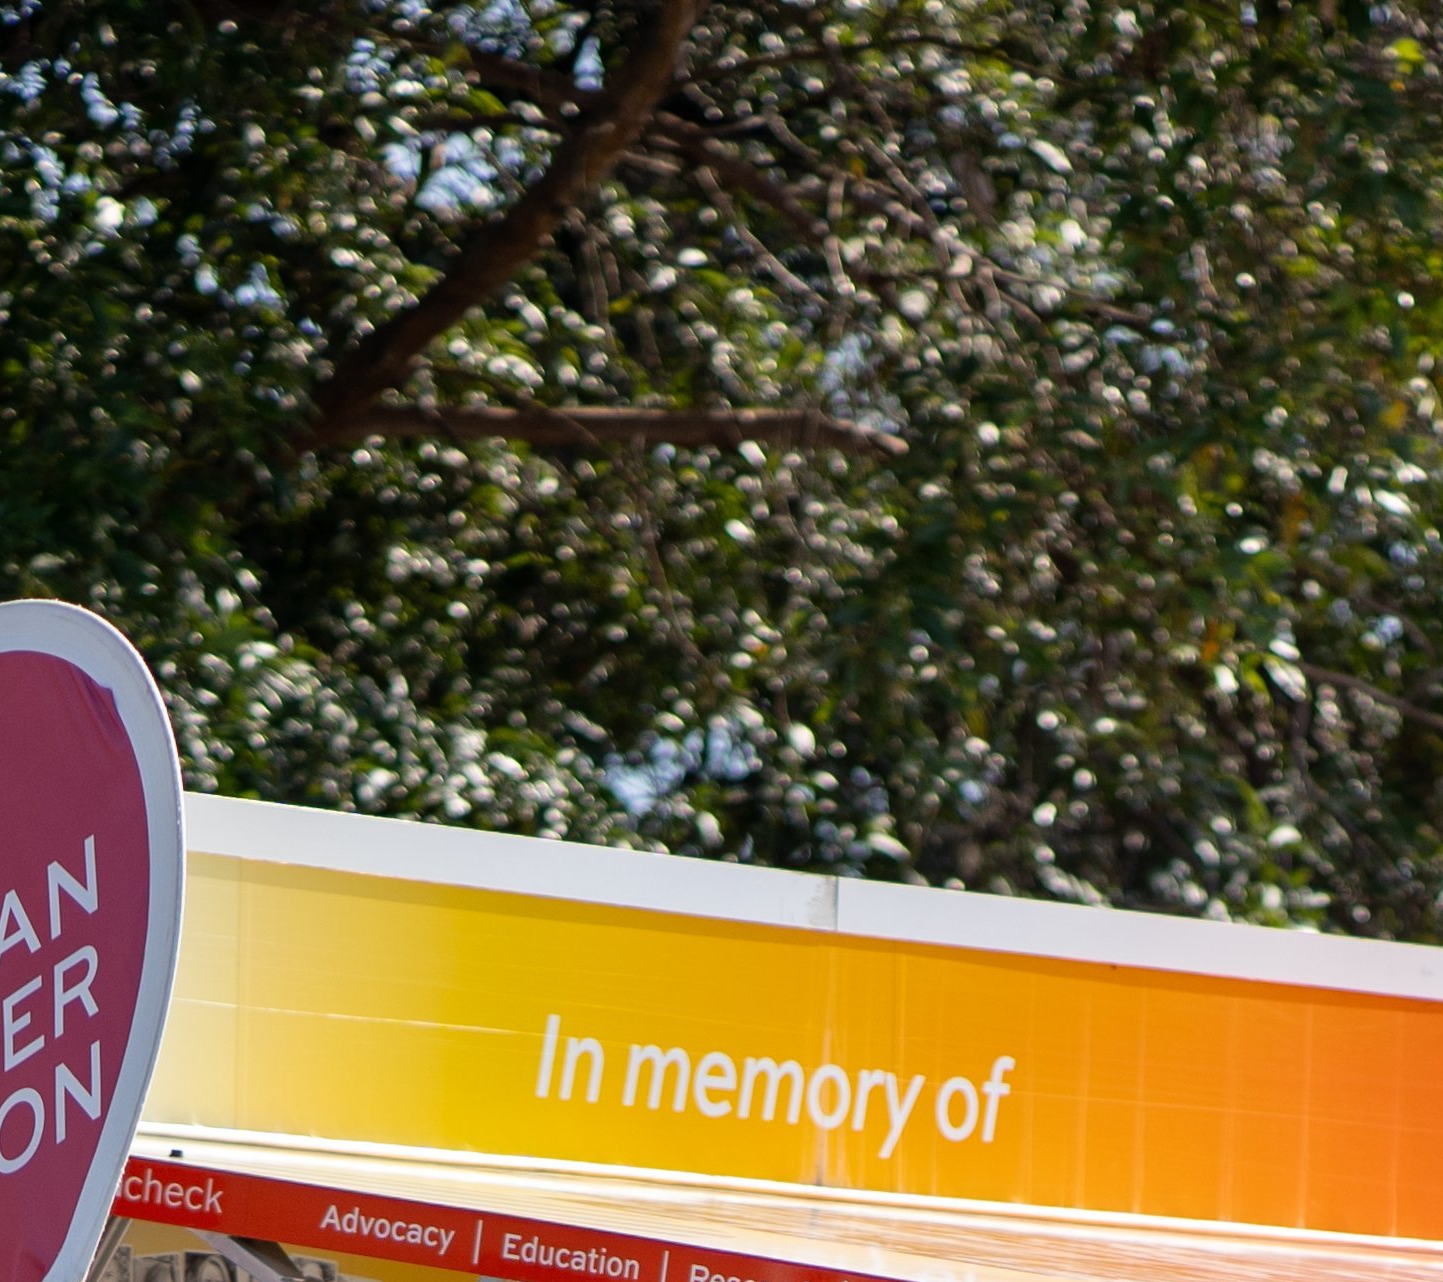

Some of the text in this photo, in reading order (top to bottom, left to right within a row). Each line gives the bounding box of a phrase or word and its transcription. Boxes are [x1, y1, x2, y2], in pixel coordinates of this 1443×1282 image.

[536, 1014, 1016, 1159] In memory of
[116, 1167, 223, 1214] check
[320, 1204, 455, 1255] Advocacy
[501, 1232, 640, 1281] Education
